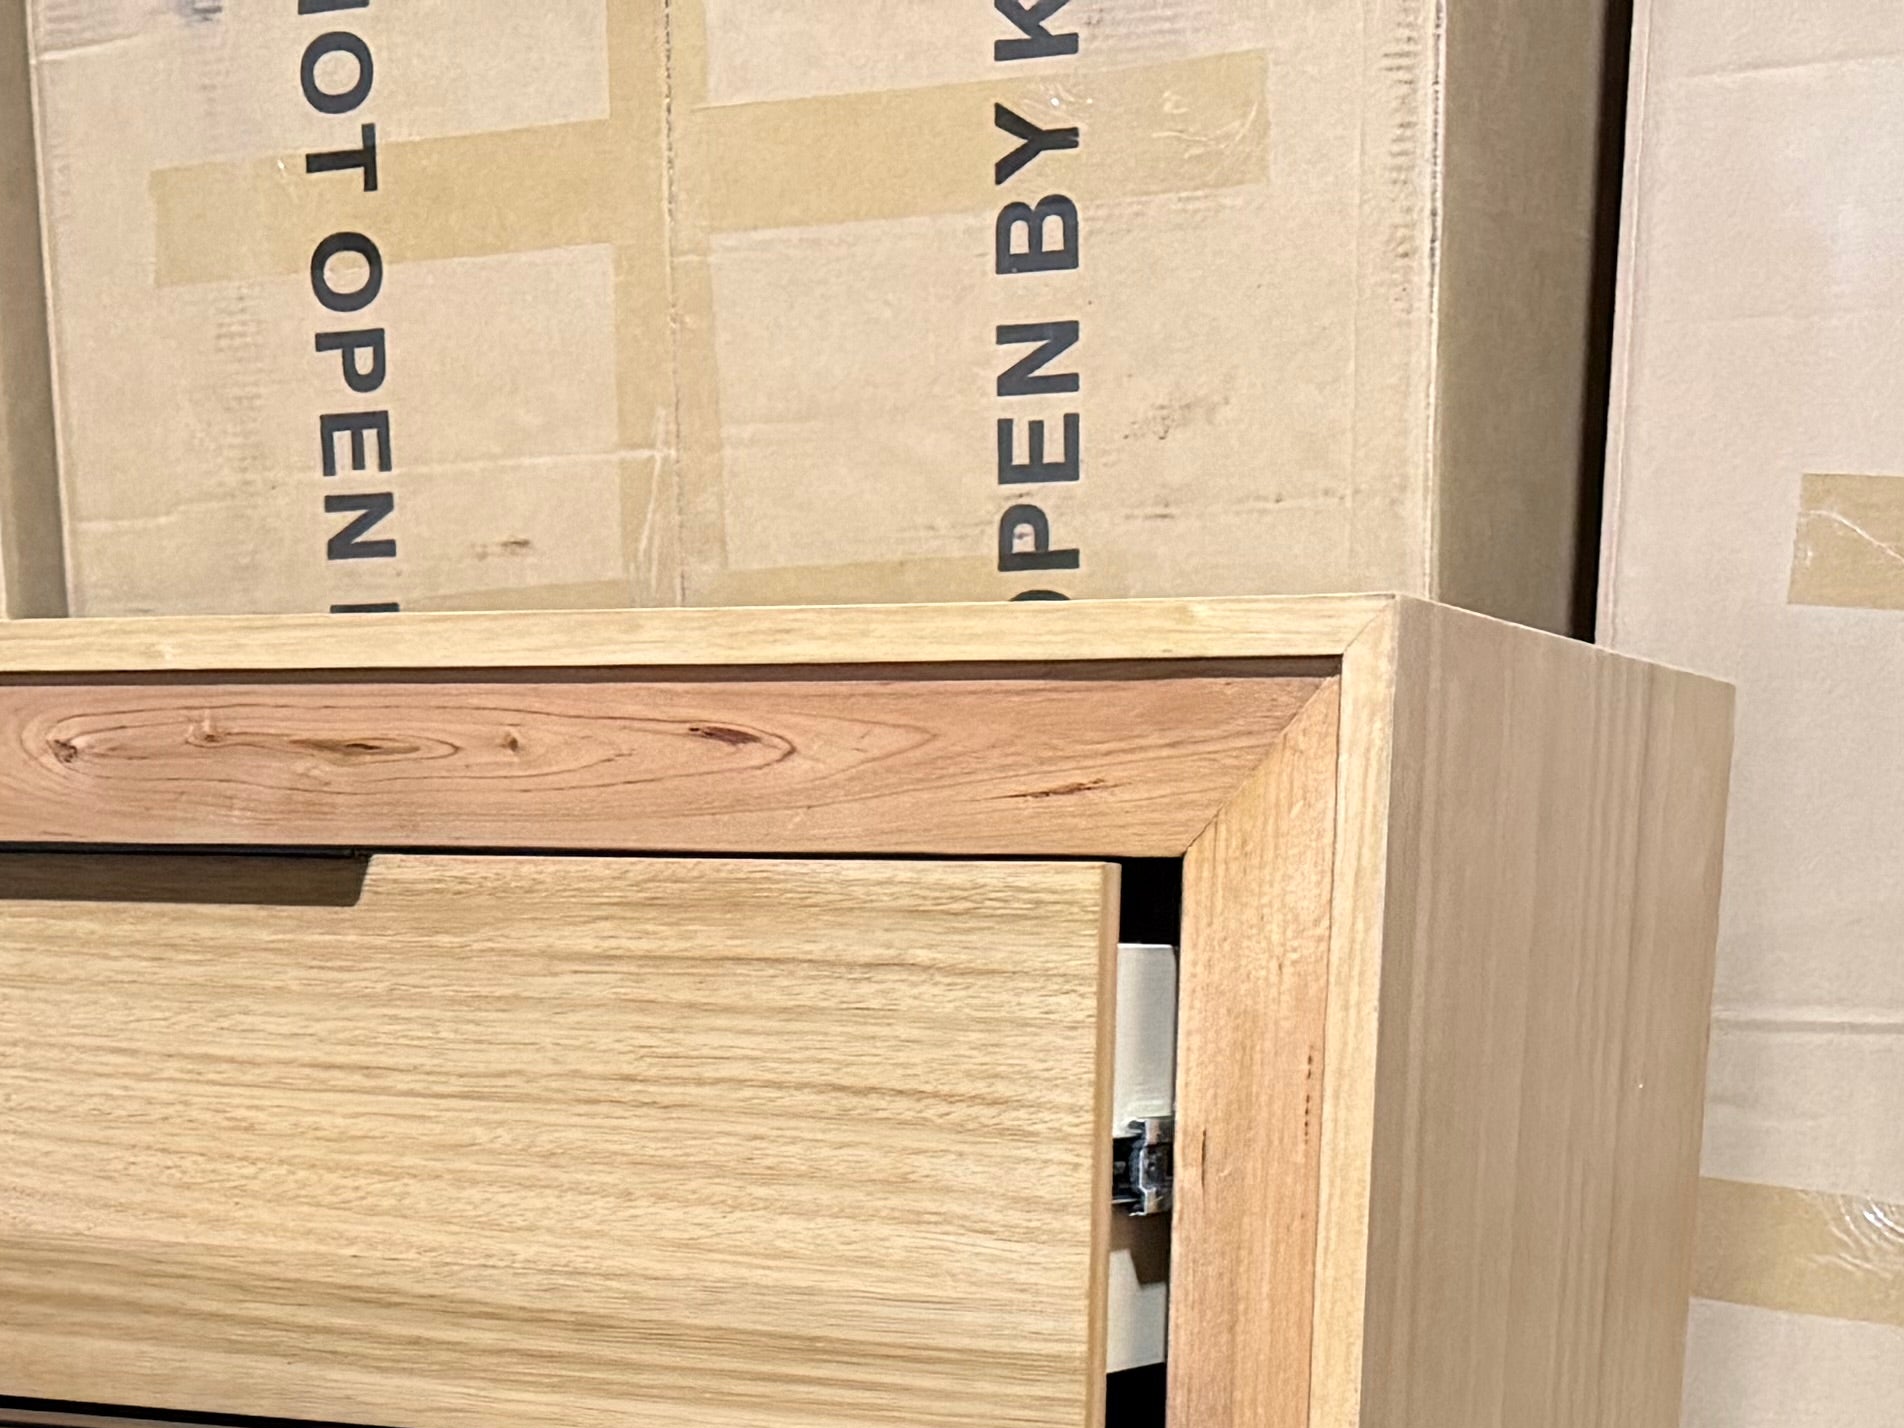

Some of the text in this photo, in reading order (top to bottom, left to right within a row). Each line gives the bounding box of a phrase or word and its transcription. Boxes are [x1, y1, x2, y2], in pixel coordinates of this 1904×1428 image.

[297, 0, 378, 192] OT
[994, 101, 1080, 275] BY
[310, 231, 397, 561] OPEN
[995, 320, 1080, 602] PEN
